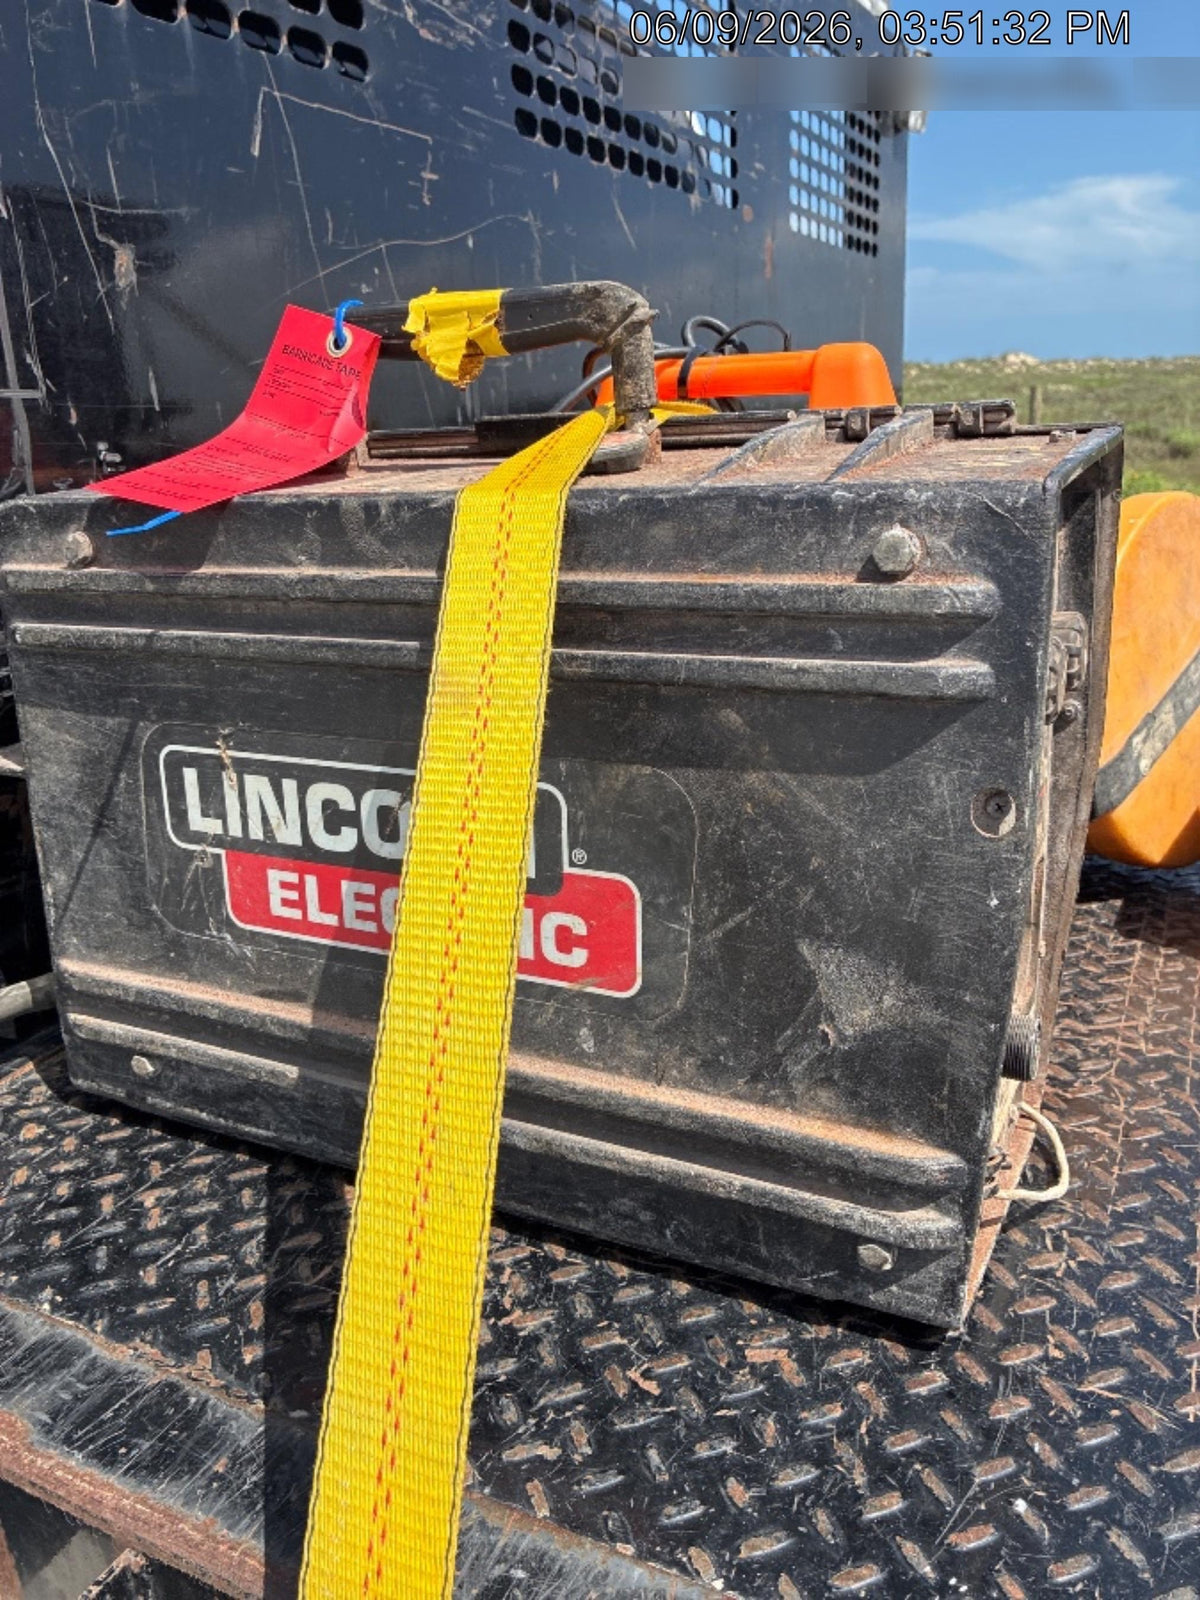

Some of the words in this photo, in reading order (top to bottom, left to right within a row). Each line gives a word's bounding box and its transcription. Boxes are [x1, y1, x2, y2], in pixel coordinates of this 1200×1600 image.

[335, 361, 361, 381] TAPE
[183, 767, 536, 879] LINCO
[266, 868, 589, 968] ELEIC
